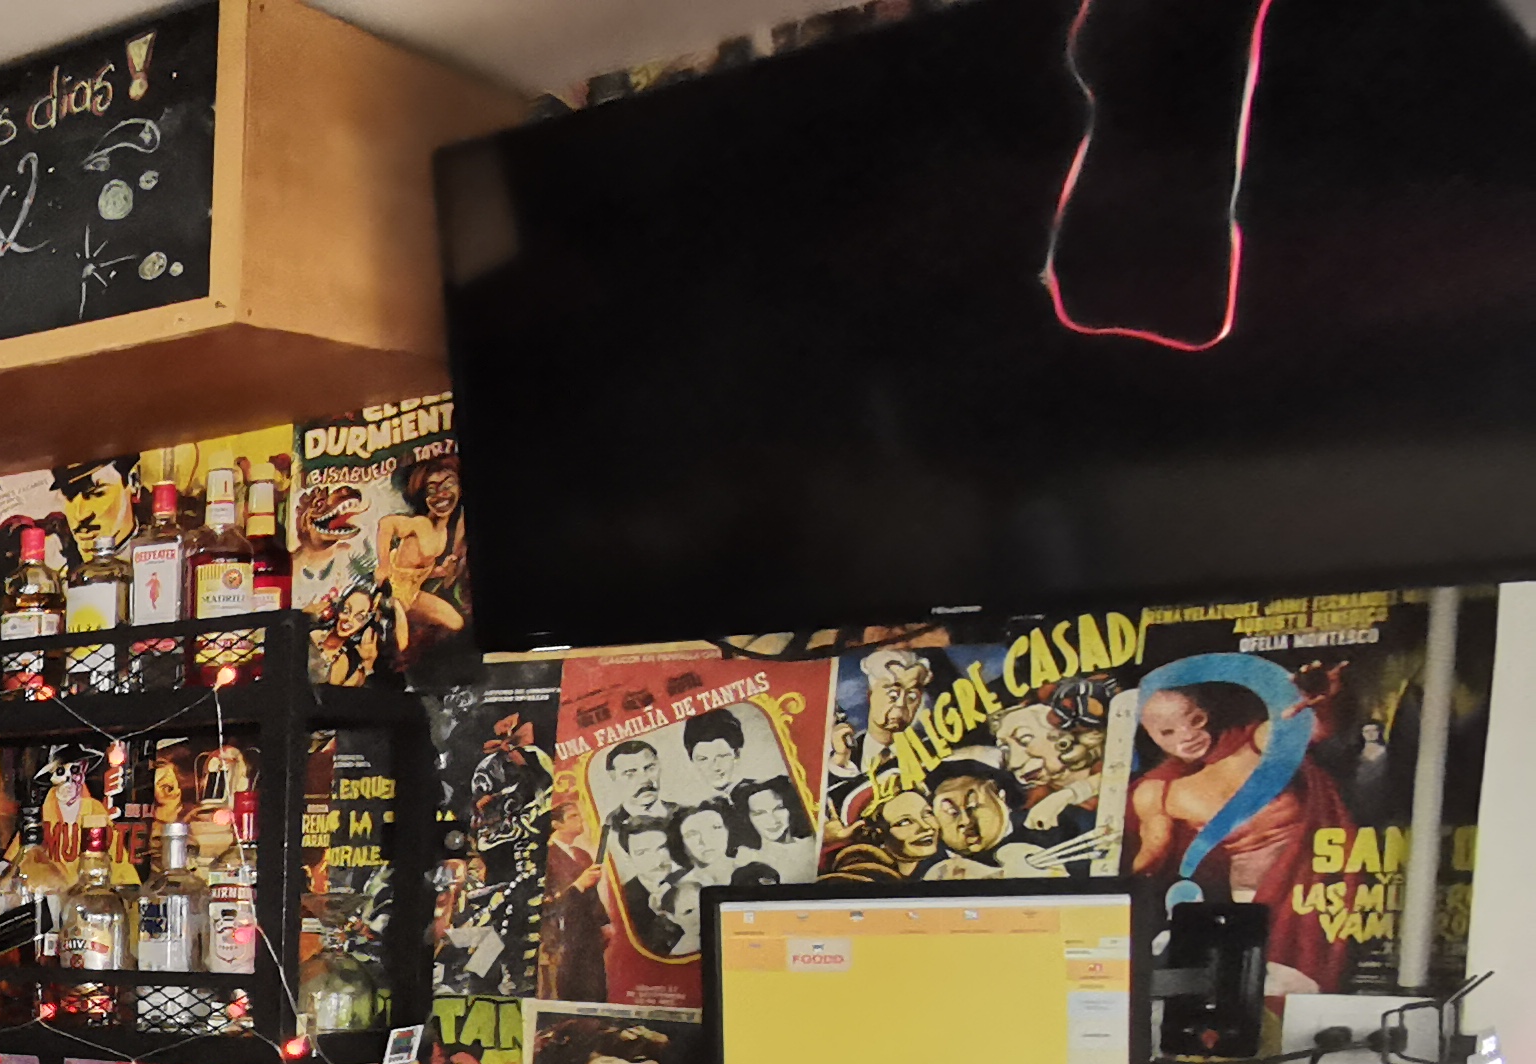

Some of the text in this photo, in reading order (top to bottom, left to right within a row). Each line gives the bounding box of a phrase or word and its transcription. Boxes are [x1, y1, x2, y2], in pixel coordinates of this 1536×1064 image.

[307, 456, 398, 486] BISABUELO
[554, 735, 591, 762] UNA
[670, 697, 697, 721] DE
[695, 671, 771, 713] TANTAS
[1292, 881, 1347, 916] LAS
